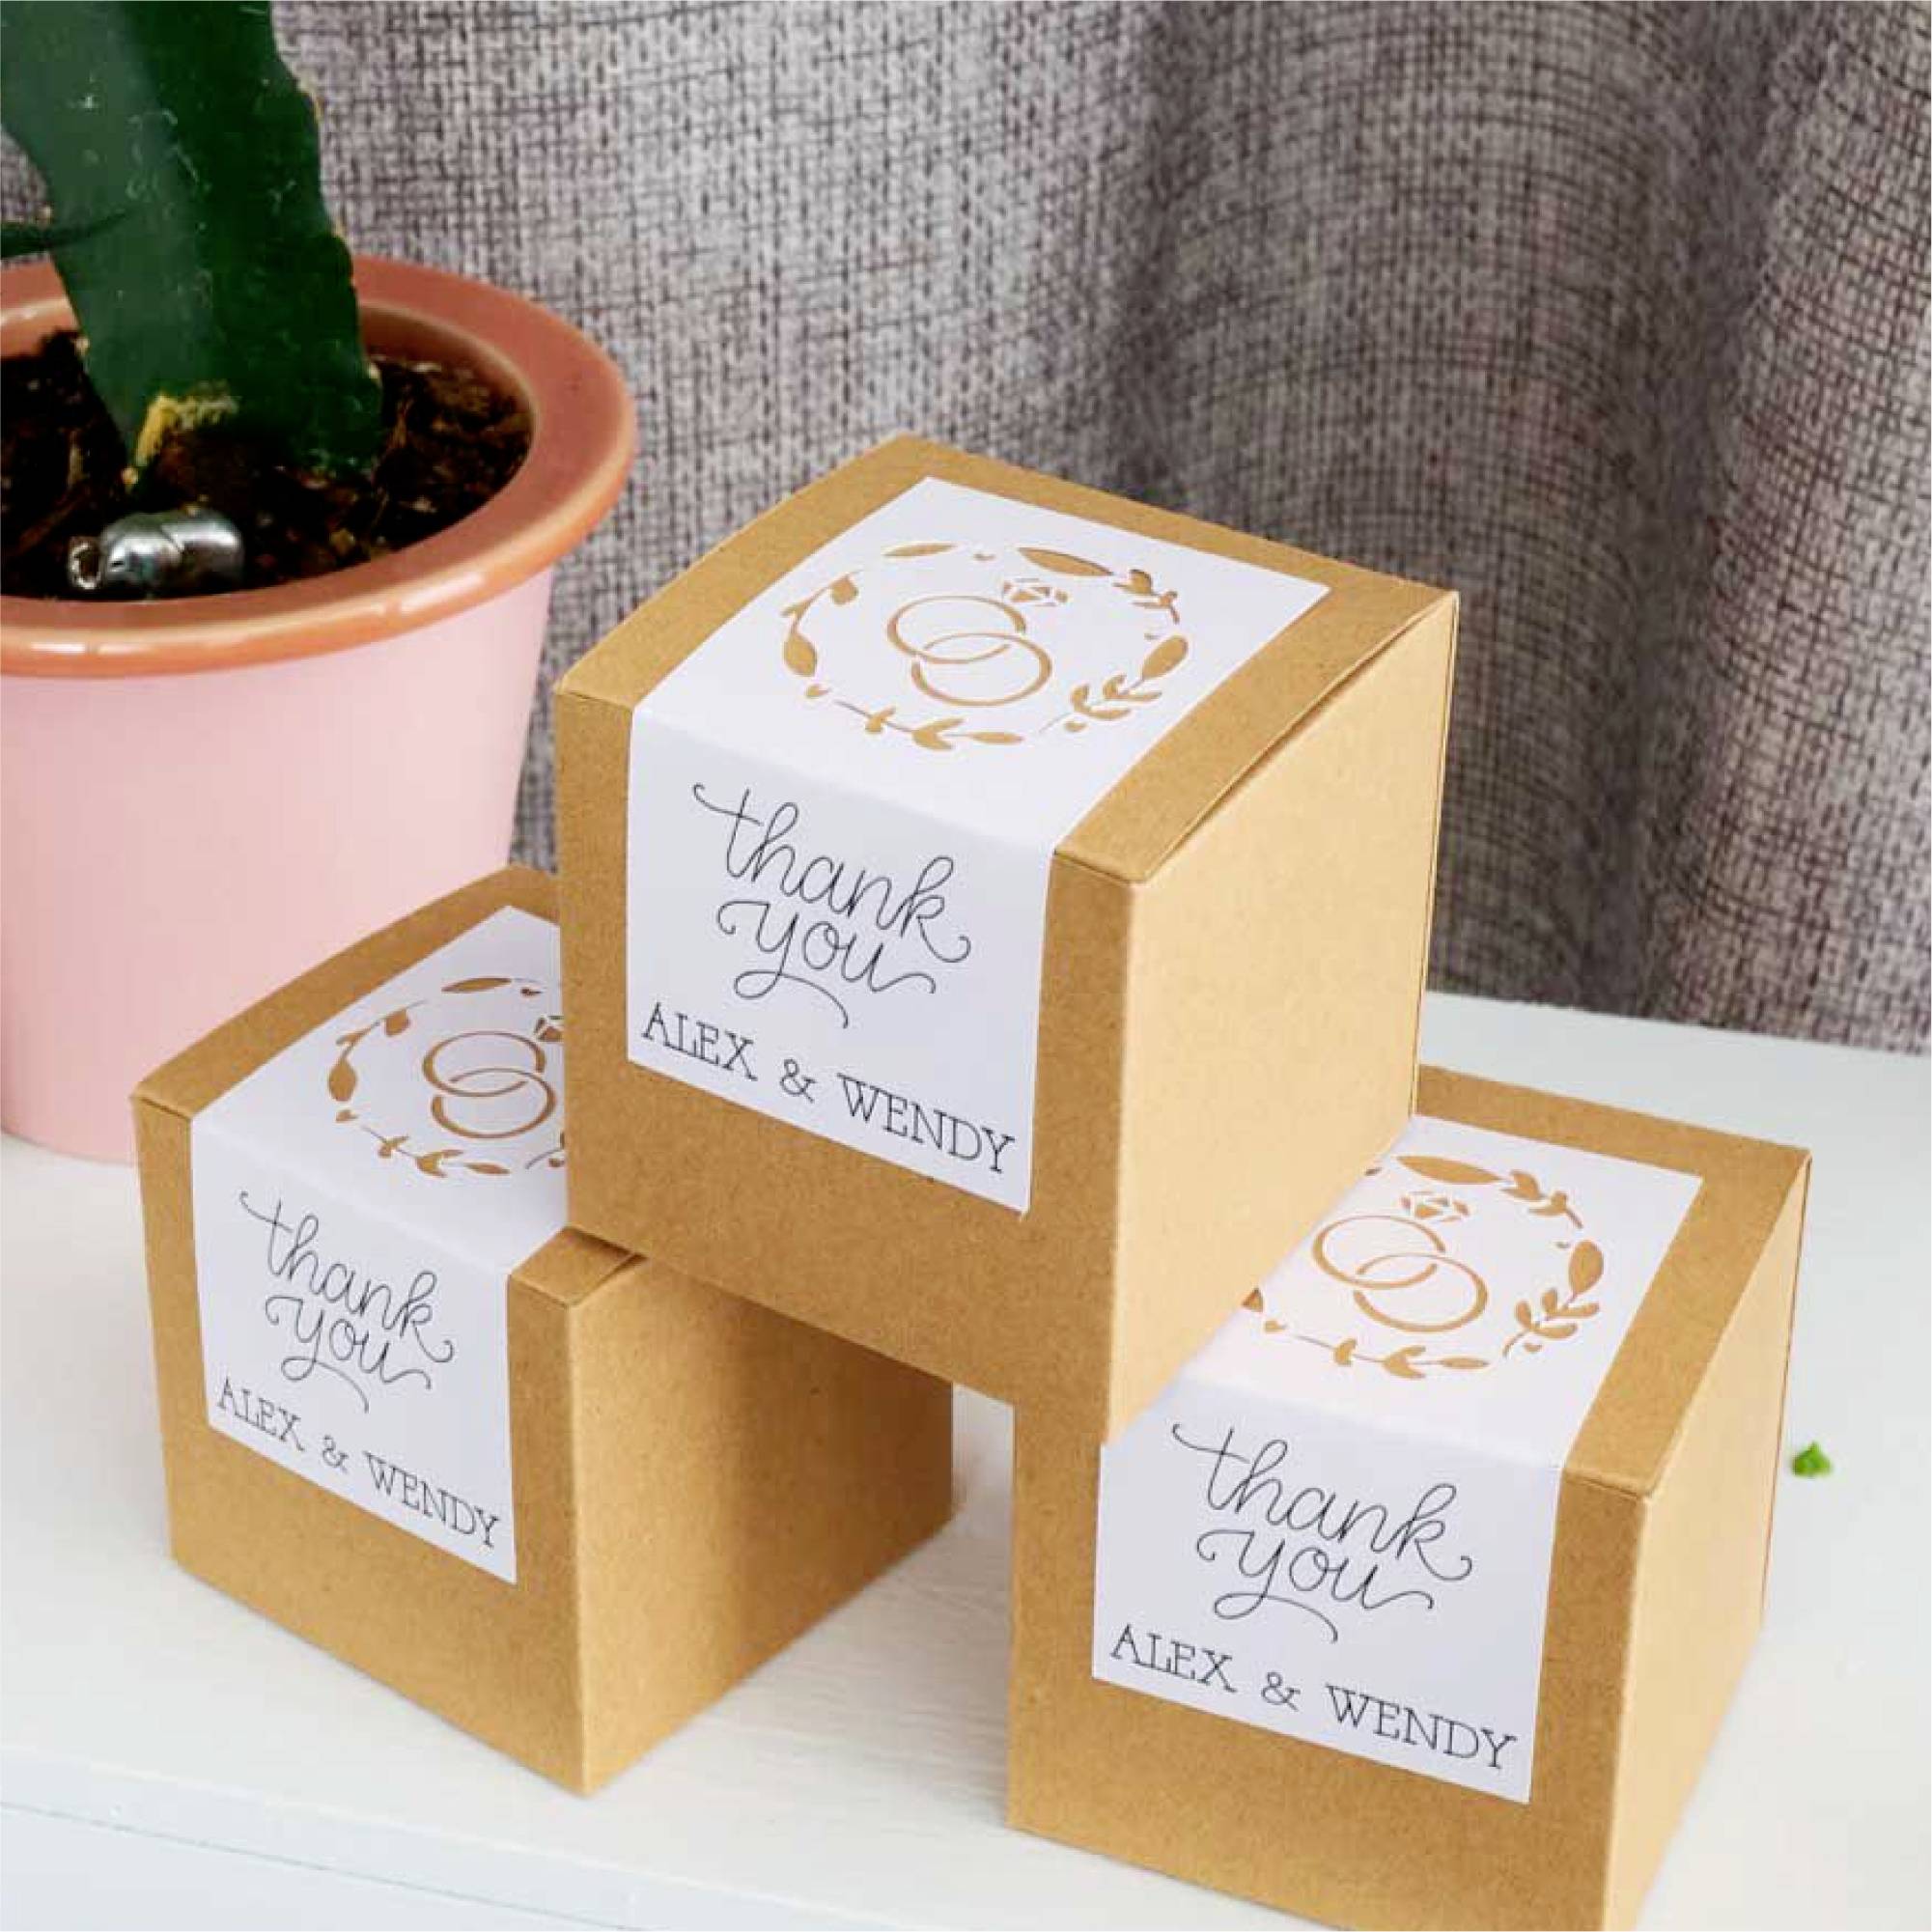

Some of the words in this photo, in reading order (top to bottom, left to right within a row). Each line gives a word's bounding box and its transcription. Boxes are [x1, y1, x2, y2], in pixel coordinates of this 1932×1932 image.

[693, 783, 971, 963] thank
[717, 900, 937, 1029] you
[641, 1002, 758, 1081] ALEX
[779, 1058, 818, 1104] &
[837, 1073, 1016, 1174] WENDY
[239, 1191, 454, 1363] thank
[266, 1296, 433, 1414] you
[217, 1377, 305, 1451] ALEX
[322, 1435, 349, 1473] &
[363, 1450, 500, 1548] WENDY
[1171, 1423, 1473, 1582] thank
[1196, 1528, 1435, 1643] you
[1110, 1624, 1238, 1694] ALEX
[1260, 1670, 1301, 1712] &
[1326, 1683, 1518, 1770] WENDY
